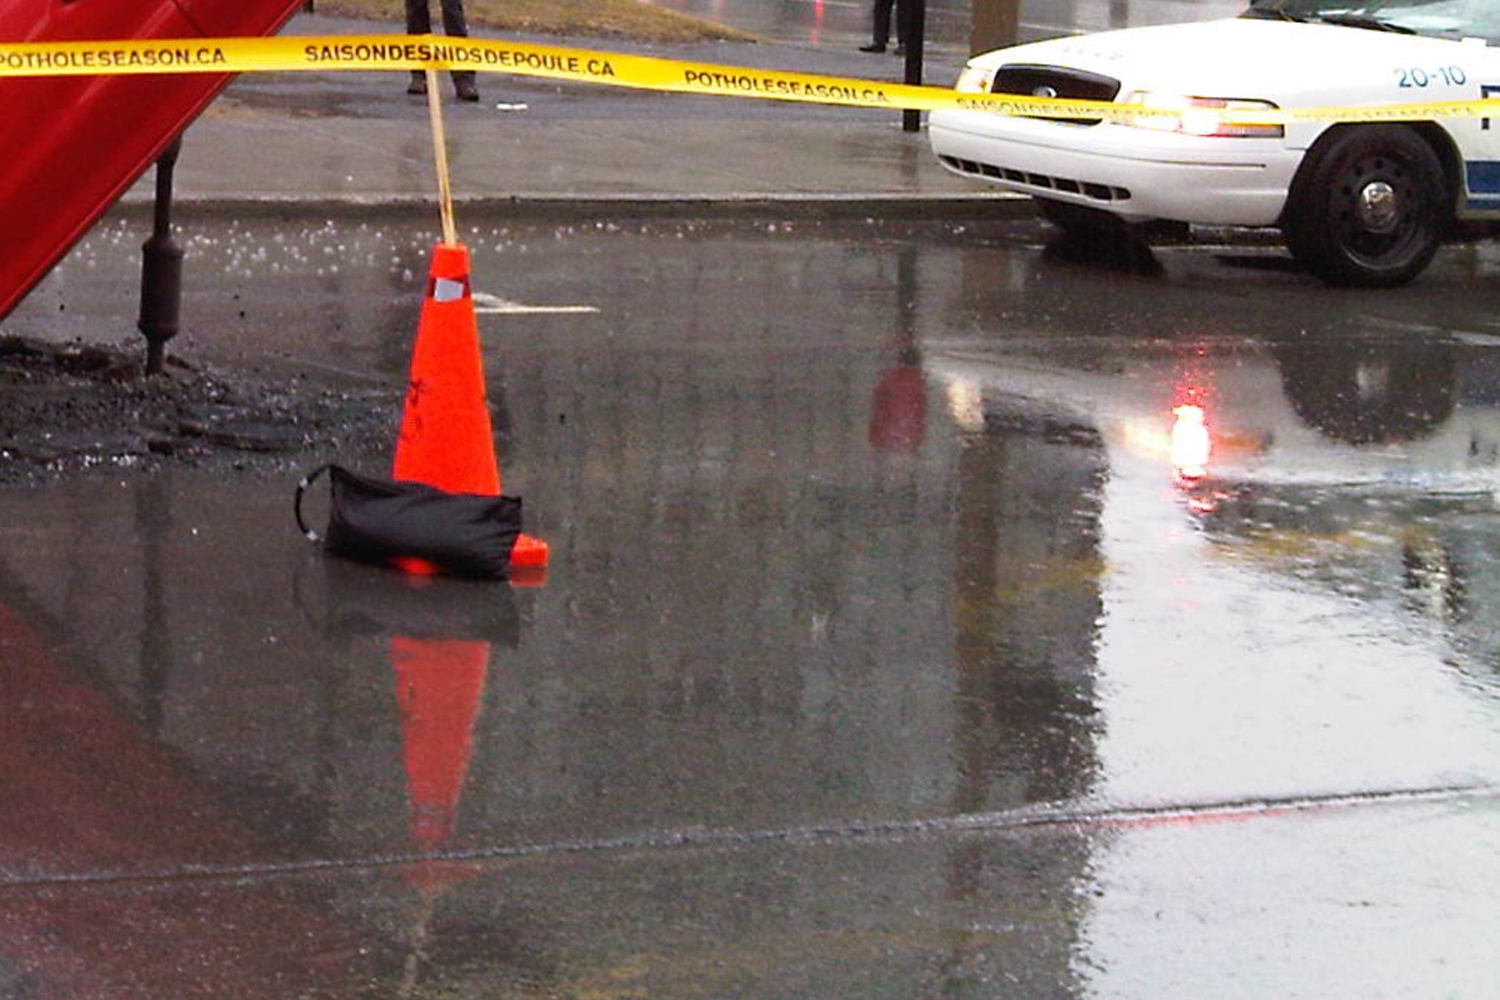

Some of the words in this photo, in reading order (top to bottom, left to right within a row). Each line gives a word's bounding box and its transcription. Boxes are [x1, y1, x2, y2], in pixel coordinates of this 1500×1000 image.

[304, 43, 616, 77] SAISONDESNIDSDEPOULE.CA
[1394, 65, 1467, 88] 20-10
[684, 69, 890, 104] POTHOLESEASON.CA
